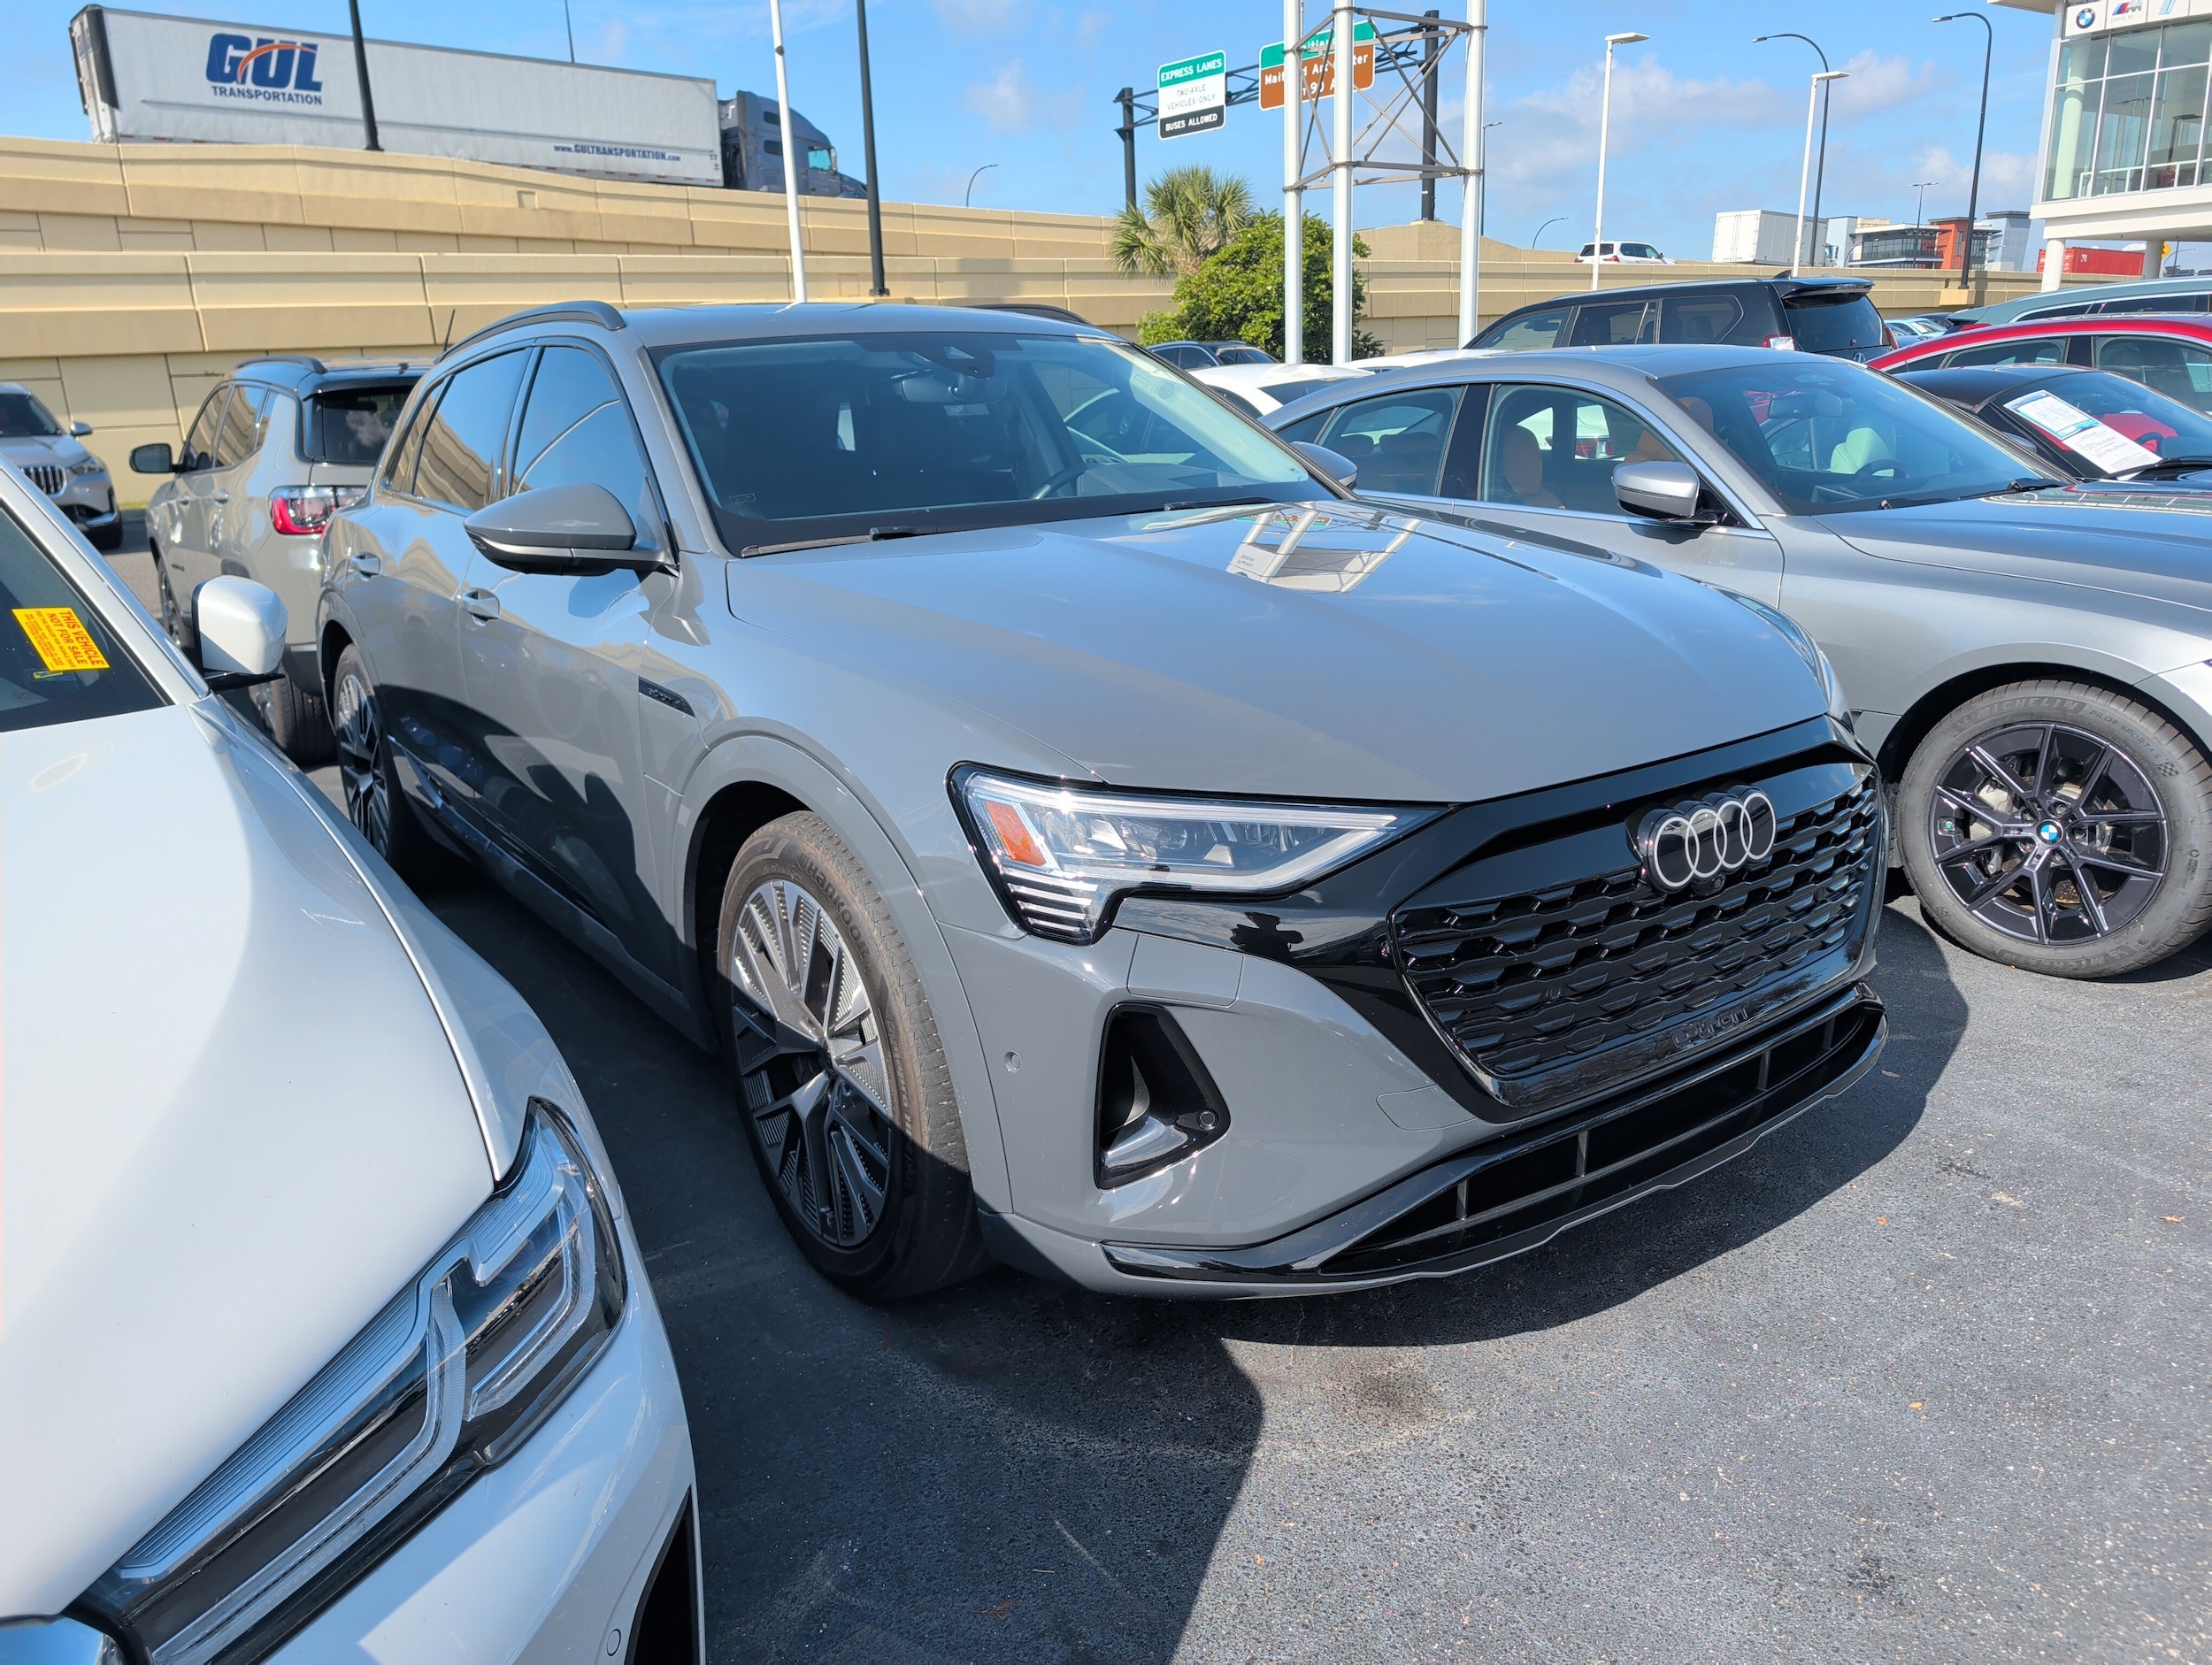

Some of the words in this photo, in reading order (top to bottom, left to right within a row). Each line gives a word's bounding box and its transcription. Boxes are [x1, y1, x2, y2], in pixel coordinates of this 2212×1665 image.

[206, 34, 323, 92] GUL
[1161, 65, 1194, 81] EXPRESS
[1197, 58, 1223, 73] LANES
[1312, 63, 1328, 75] Art
[211, 86, 323, 105] TRANSPORTATION
[1177, 84, 1206, 97] TWO-AXLE
[1167, 97, 1195, 110] VEHICLES
[1199, 94, 1216, 104] ONLY
[1165, 120, 1186, 131] BUSES
[1188, 113, 1217, 127] ALLOWED
[554, 144, 681, 162] www.GULTRANSPORTATION.com
[47, 613, 64, 627] NOT
[57, 629, 73, 644] FOR
[68, 645, 88, 664] SALE
[59, 611, 81, 628] THIS
[73, 631, 104, 665] VEHICLE
[1978, 698, 2077, 717] MICHELIN
[2089, 710, 2118, 725] PILOT
[2120, 725, 2152, 748] SPORT
[1671, 1008, 1748, 1049] e-tron
